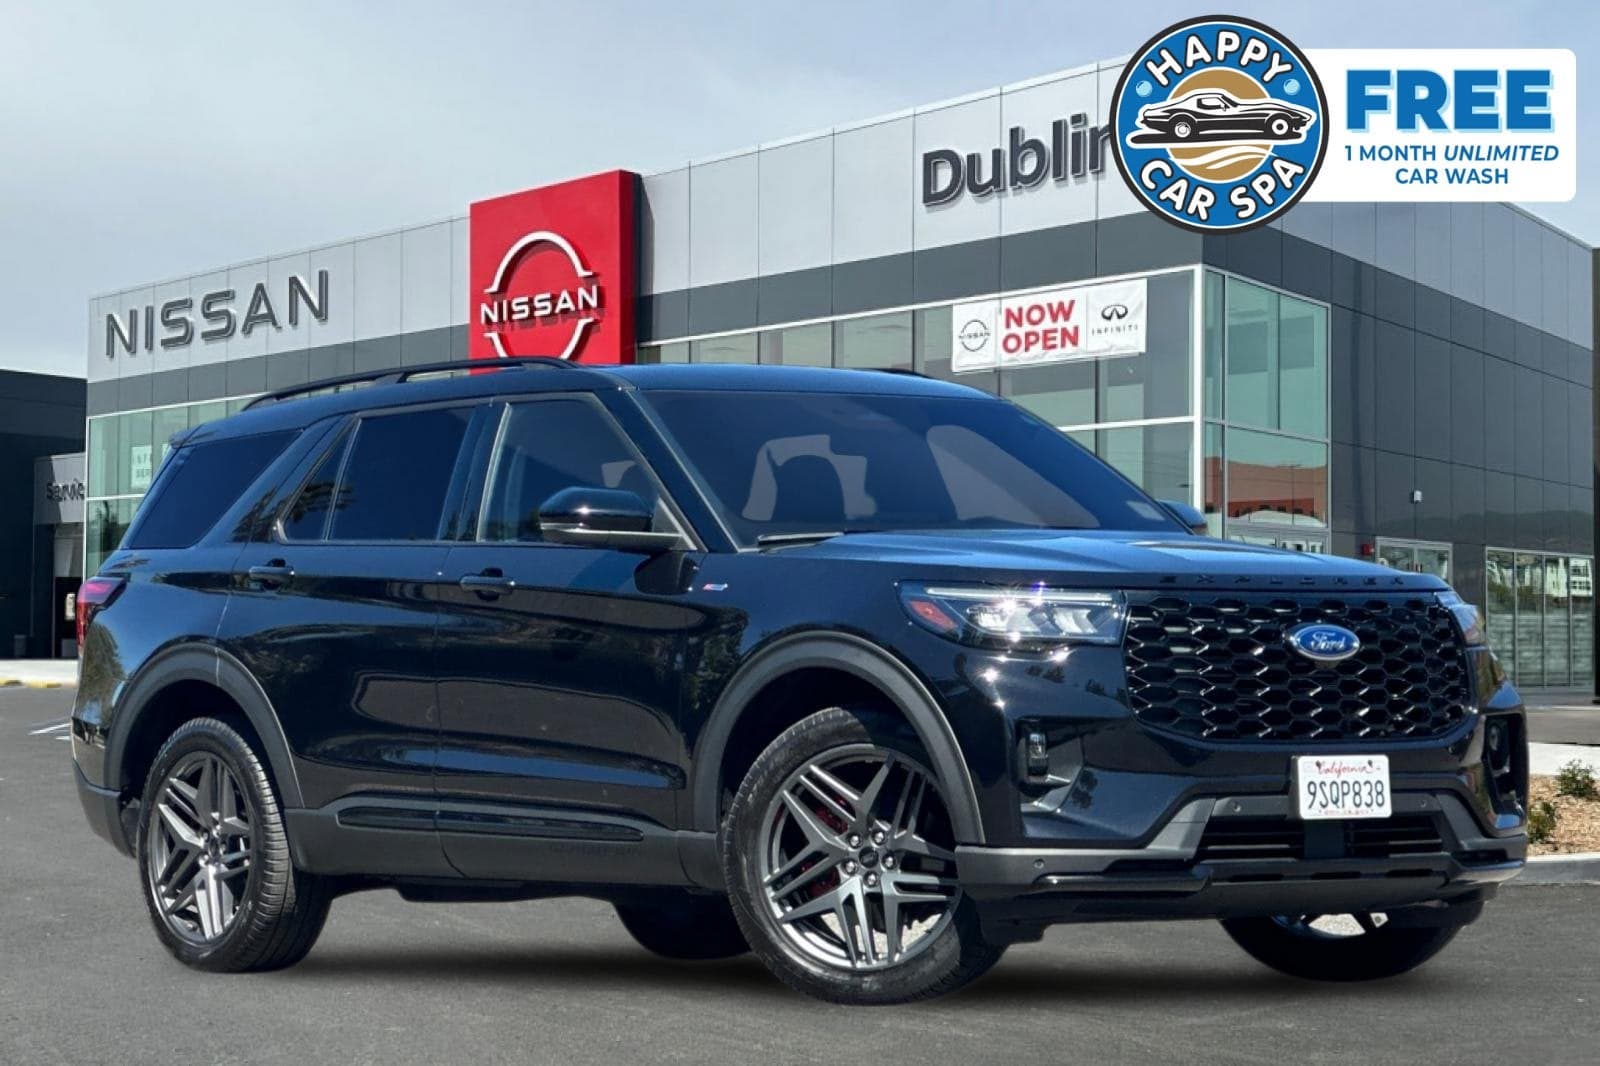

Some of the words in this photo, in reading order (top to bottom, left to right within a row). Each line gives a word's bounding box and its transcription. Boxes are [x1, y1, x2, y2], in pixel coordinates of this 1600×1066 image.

[105, 269, 329, 358] NISSAN
[480, 284, 599, 325] NISSAN
[1003, 299, 1076, 330] NOW
[1002, 325, 1080, 355] OPEN
[1091, 324, 1138, 337] INFINITI
[1310, 631, 1347, 651] Ford
[1306, 780, 1385, 809] 9SQP838
